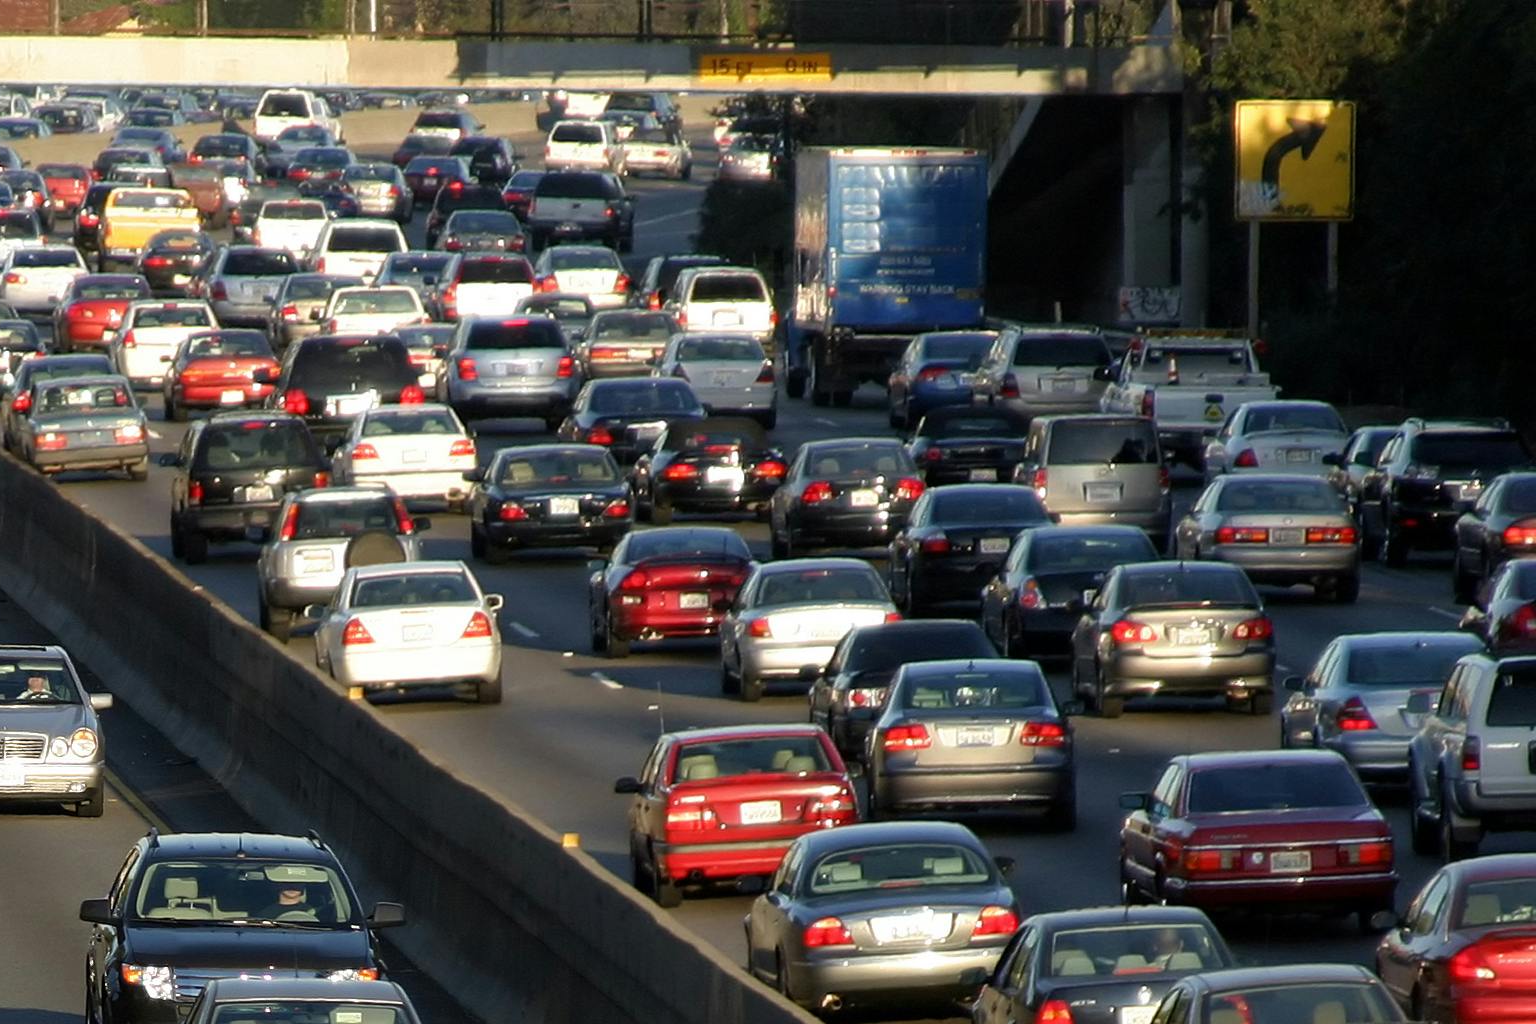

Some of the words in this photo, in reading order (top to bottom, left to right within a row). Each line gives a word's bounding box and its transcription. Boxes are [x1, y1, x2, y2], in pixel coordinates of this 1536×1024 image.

[711, 58, 730, 75] 15
[735, 61, 754, 75] FT
[803, 61, 818, 73] IN
[905, 284, 928, 293] STAY
